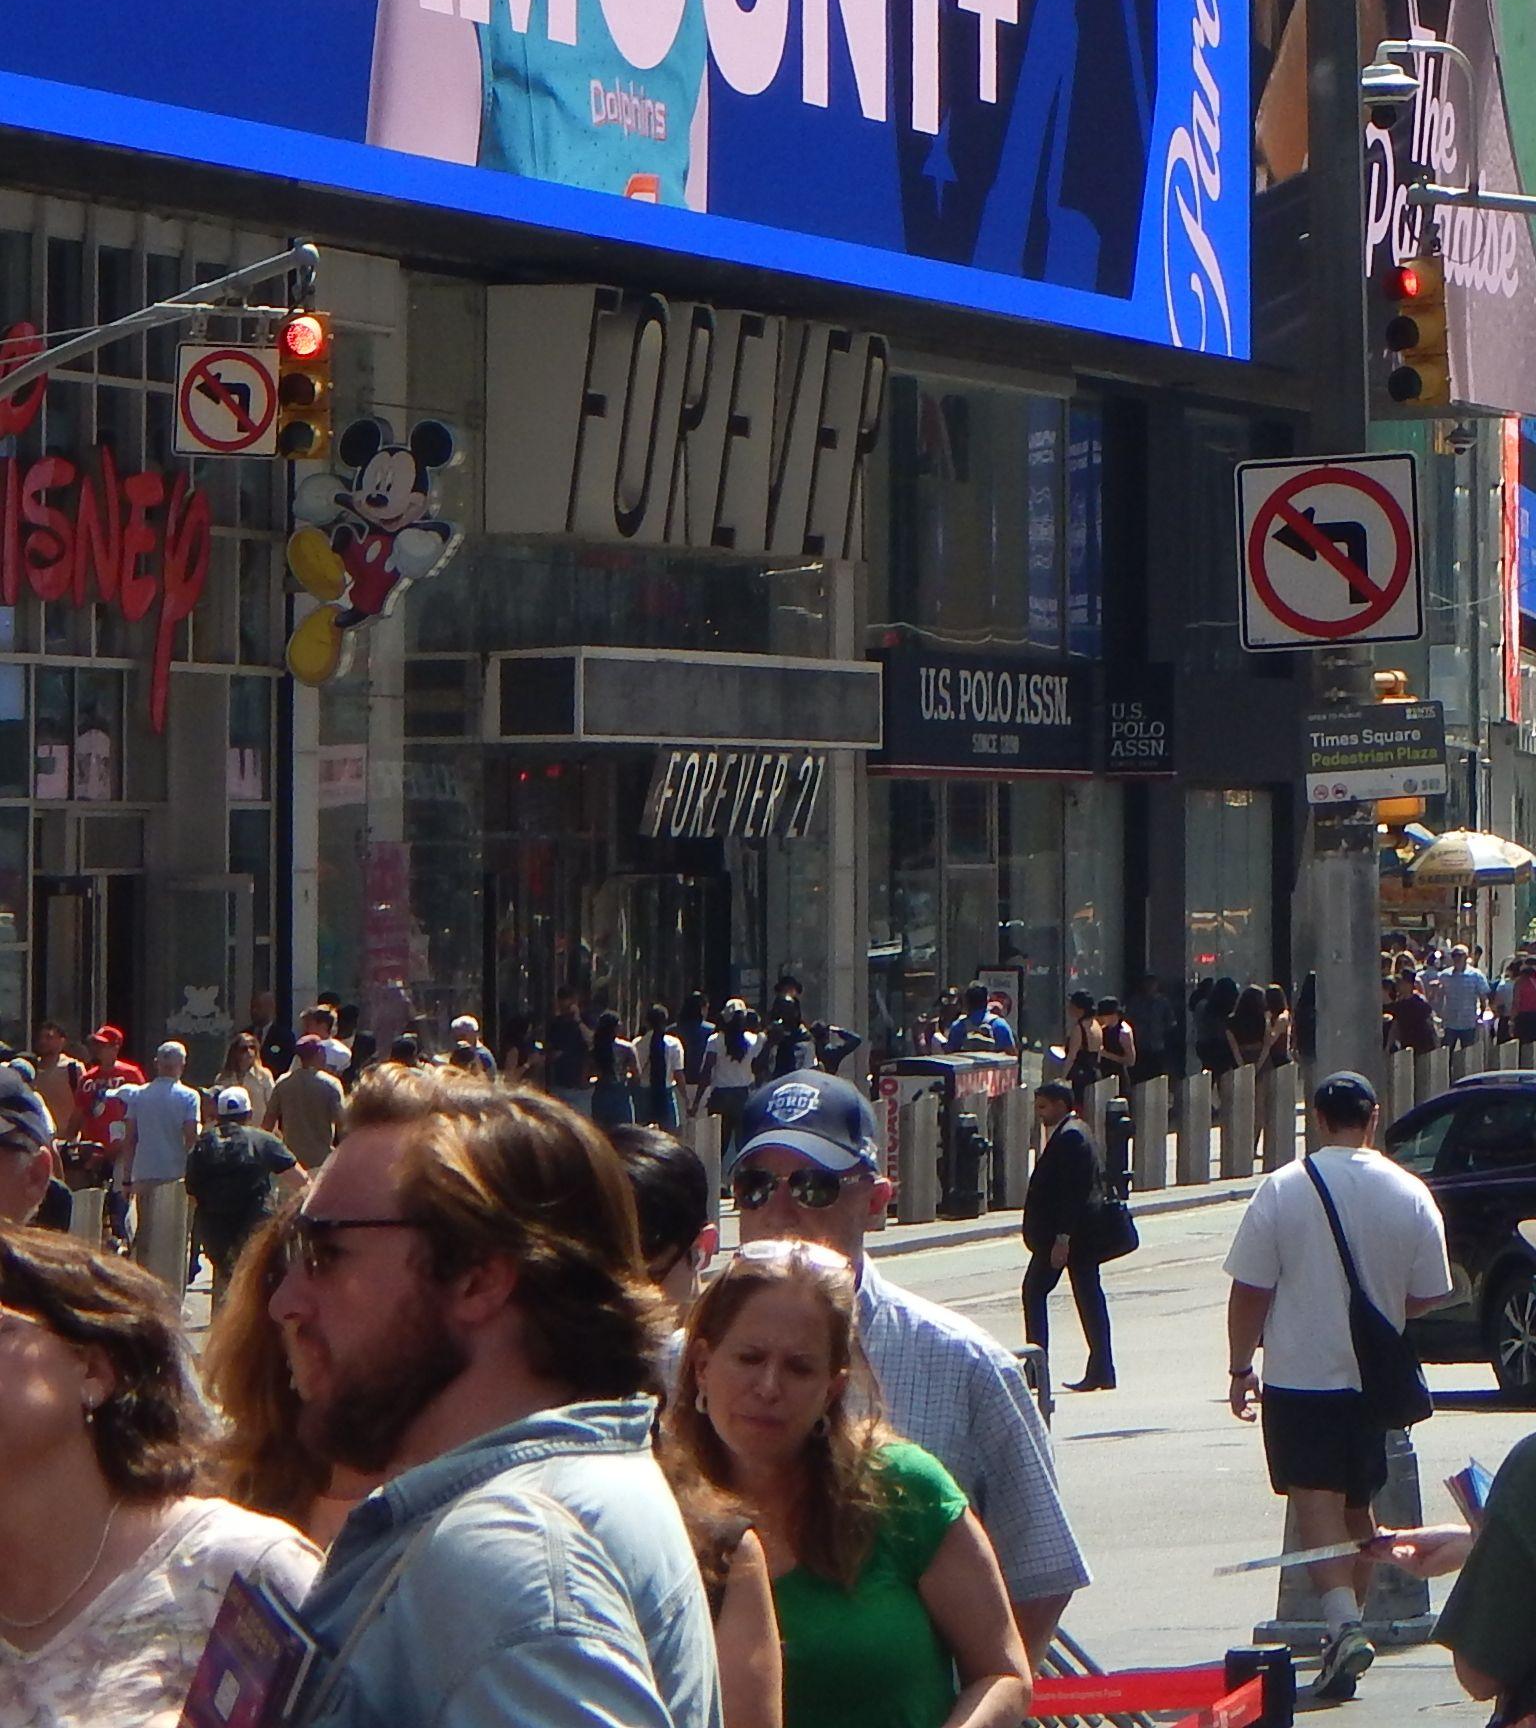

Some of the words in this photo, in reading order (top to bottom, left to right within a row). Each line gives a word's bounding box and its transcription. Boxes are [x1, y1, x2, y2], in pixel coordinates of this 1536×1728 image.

[590, 77, 667, 141] Dolphins
[566, 283, 890, 562] FOREVER
[919, 667, 956, 721] U.S.
[958, 669, 1013, 723] POLO
[1015, 673, 1072, 726] ASSN.
[1111, 702, 1147, 721] U.S.
[1111, 721, 1166, 739] POLO
[1309, 731, 1359, 748] Times
[1361, 728, 1422, 747] Square
[1111, 739, 1169, 758] ASSN.
[1311, 751, 1395, 768] Pedestrian
[1397, 746, 1439, 761] Plaza
[651, 751, 781, 839] FOREVER
[785, 755, 827, 839] 21
[766, 1094, 819, 1112] FORCE
